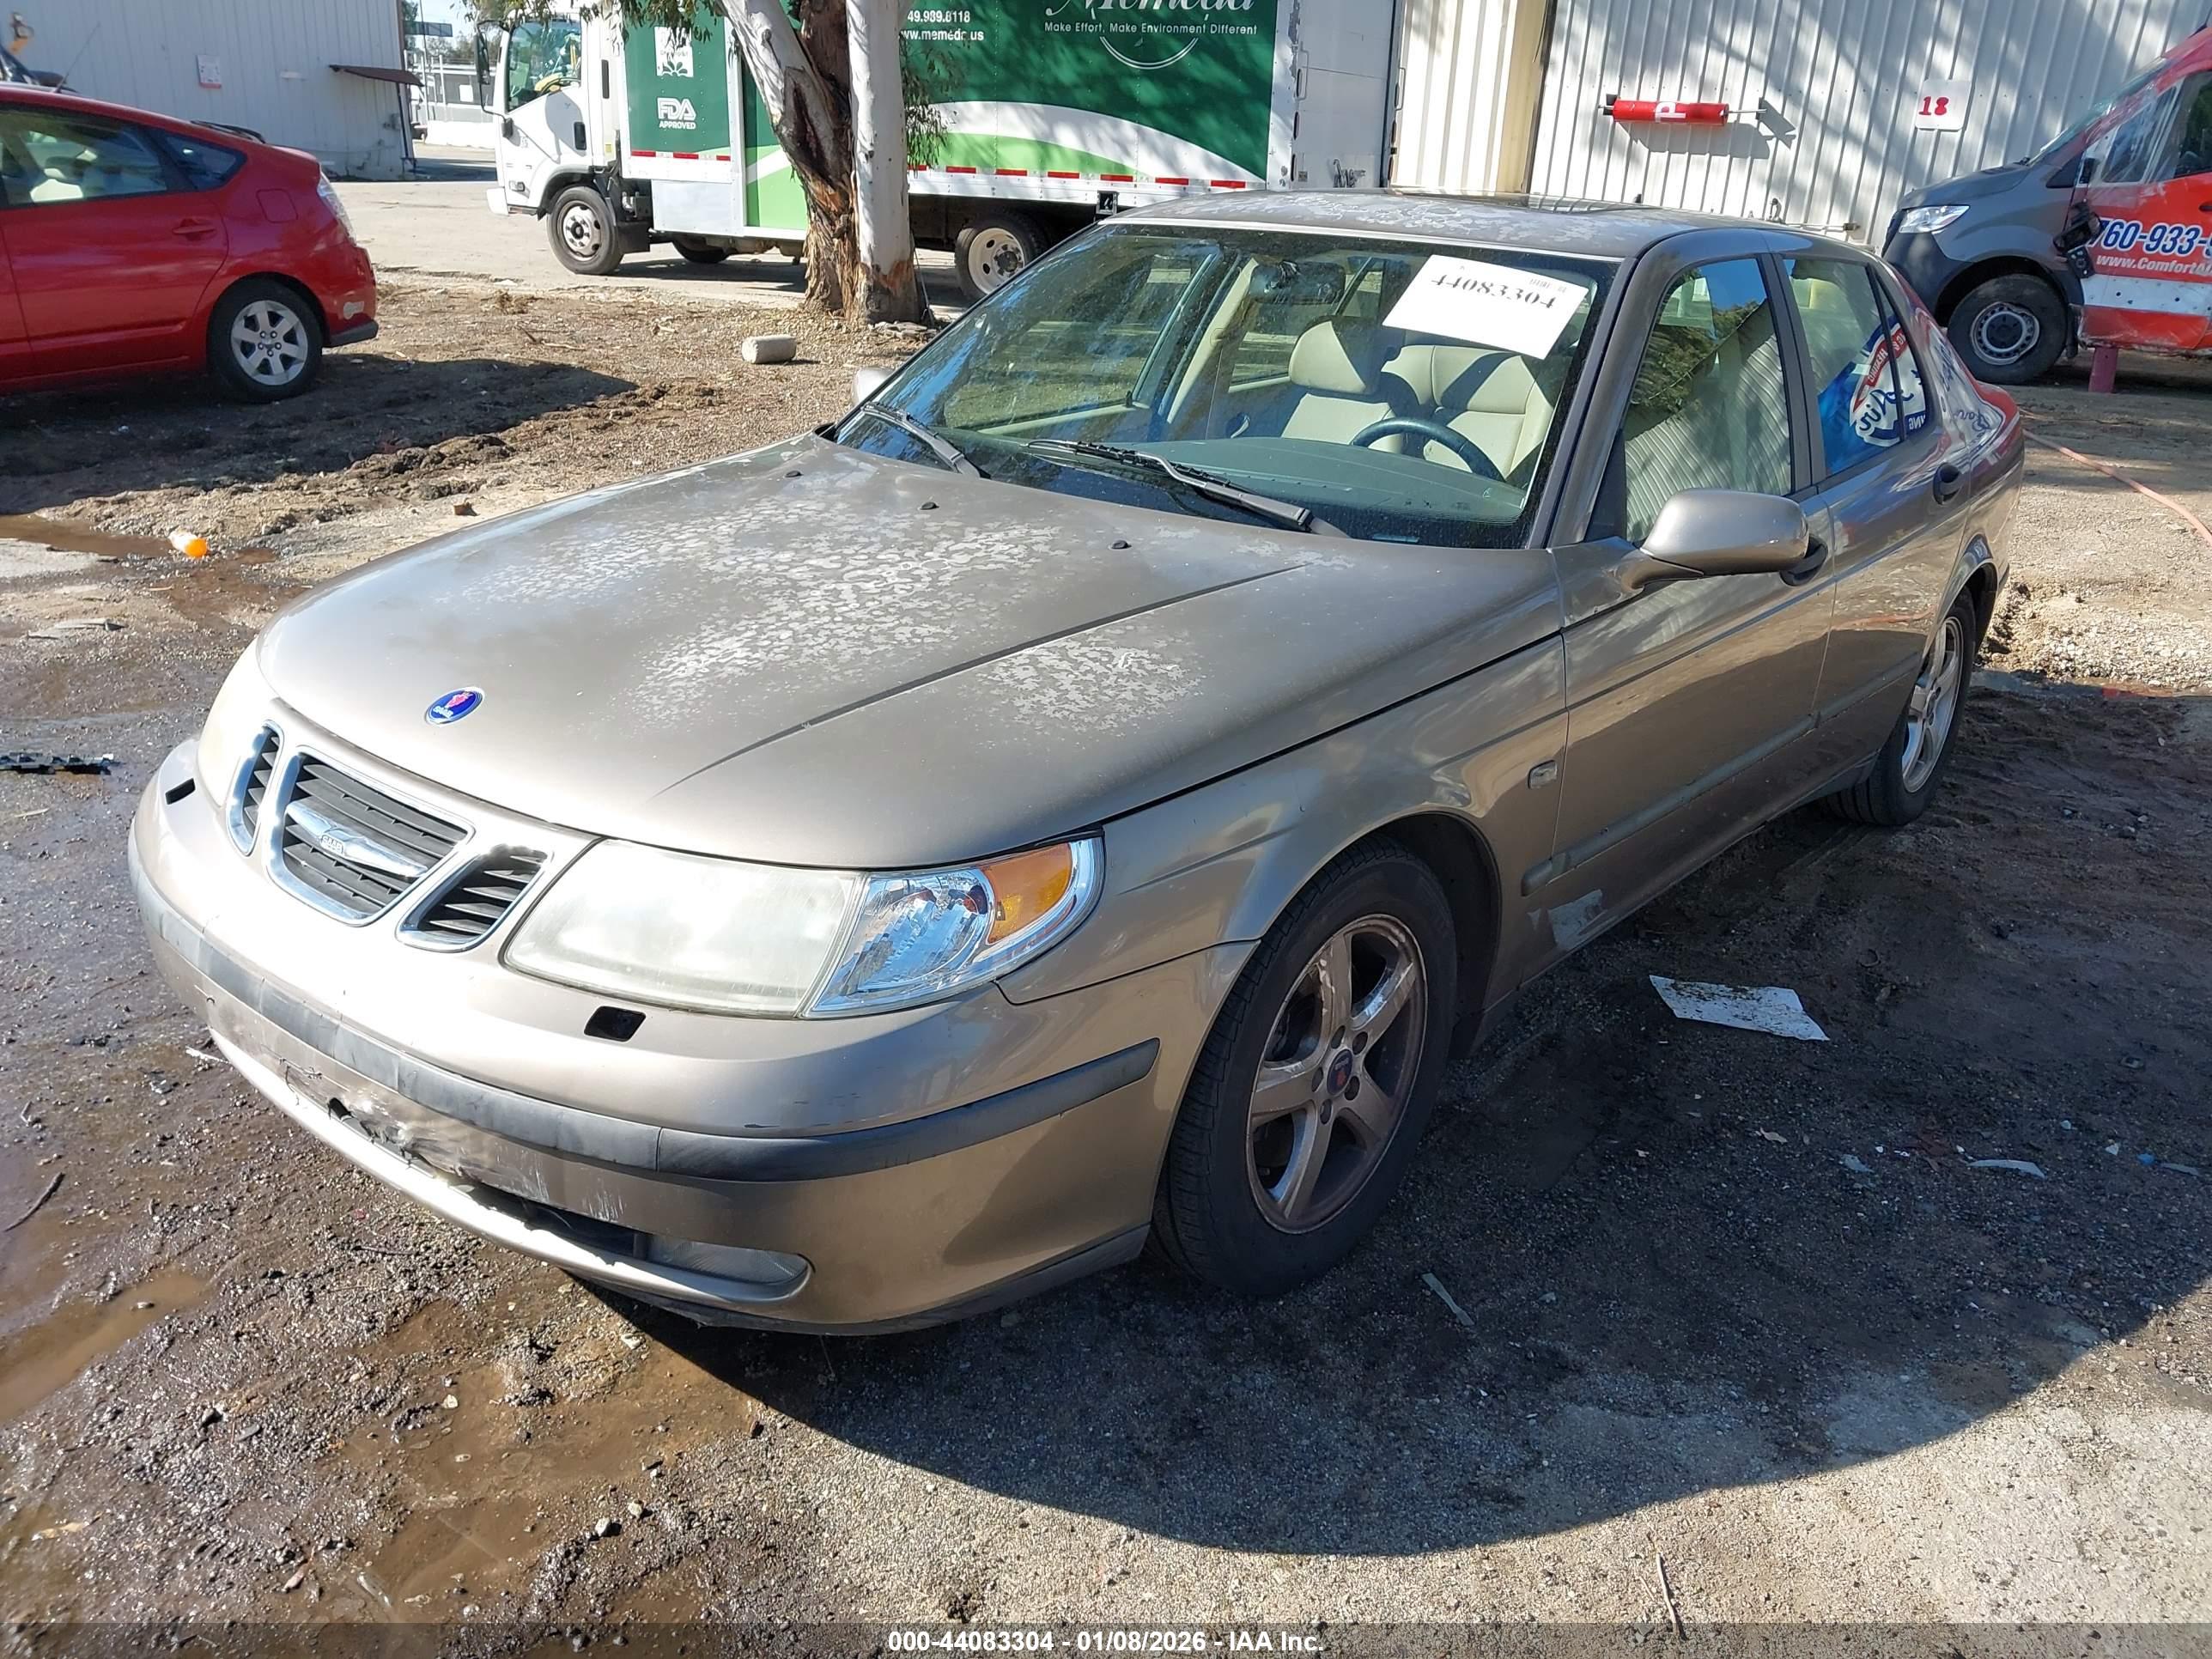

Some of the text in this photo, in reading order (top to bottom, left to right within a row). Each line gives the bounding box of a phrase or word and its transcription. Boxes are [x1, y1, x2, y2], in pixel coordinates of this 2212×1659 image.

[1045, 22, 1257, 34] Make Effort, Make Environment Different
[657, 97, 696, 120] FDA
[1918, 96, 1949, 115] 18
[659, 121, 696, 130] APPROVED
[1431, 274, 1557, 309] 44083304
